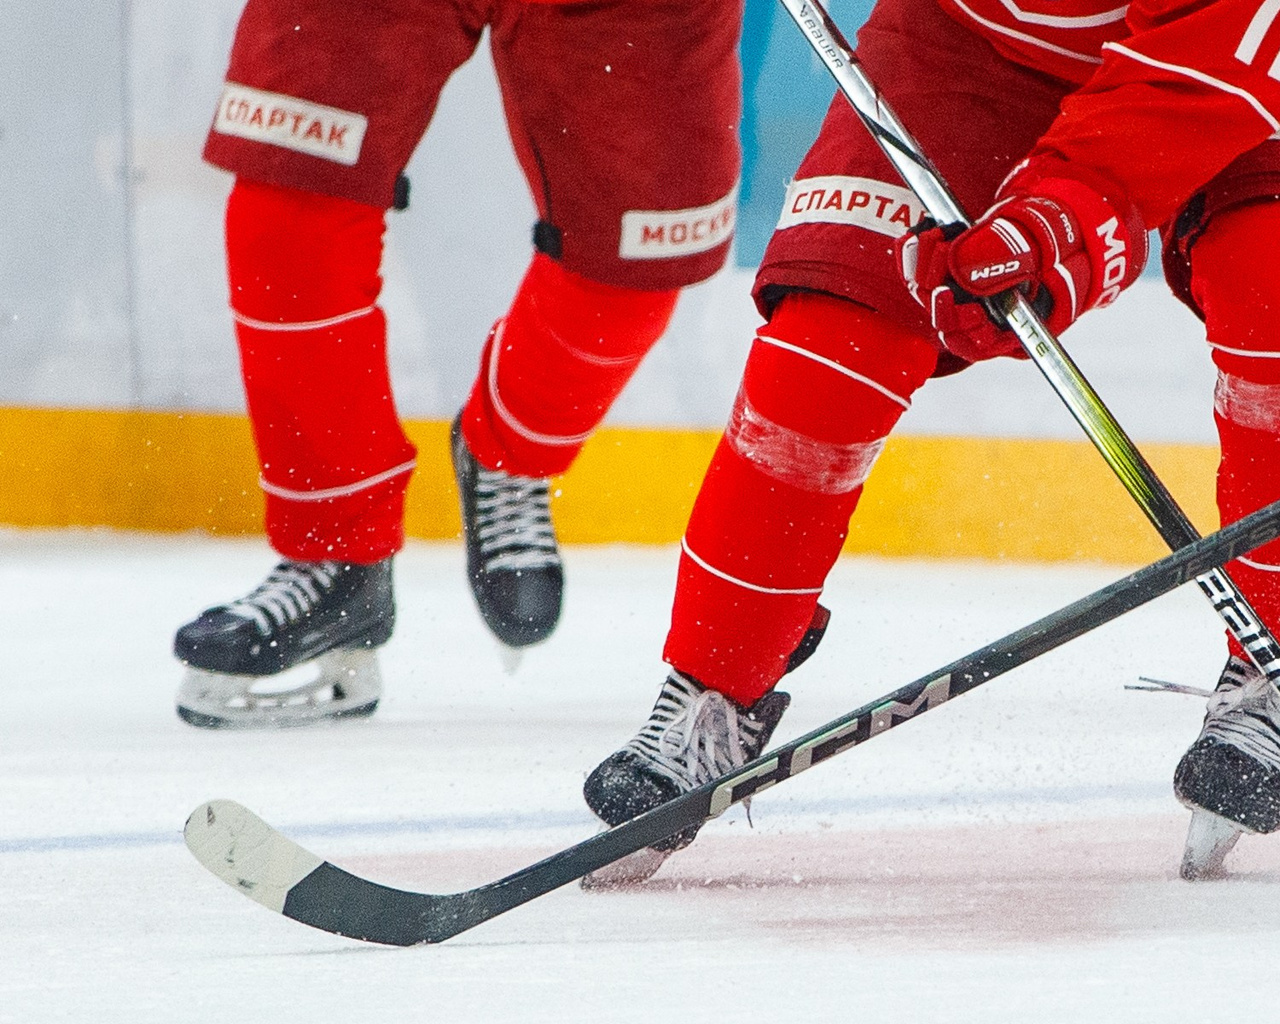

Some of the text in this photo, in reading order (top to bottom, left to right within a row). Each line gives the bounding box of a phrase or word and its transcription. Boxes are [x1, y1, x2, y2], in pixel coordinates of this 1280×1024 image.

[226, 98, 347, 150] СПАРТАК
[1059, 213, 1075, 244] PRO
[970, 260, 1021, 281] CCM
[709, 674, 951, 815] CCM
